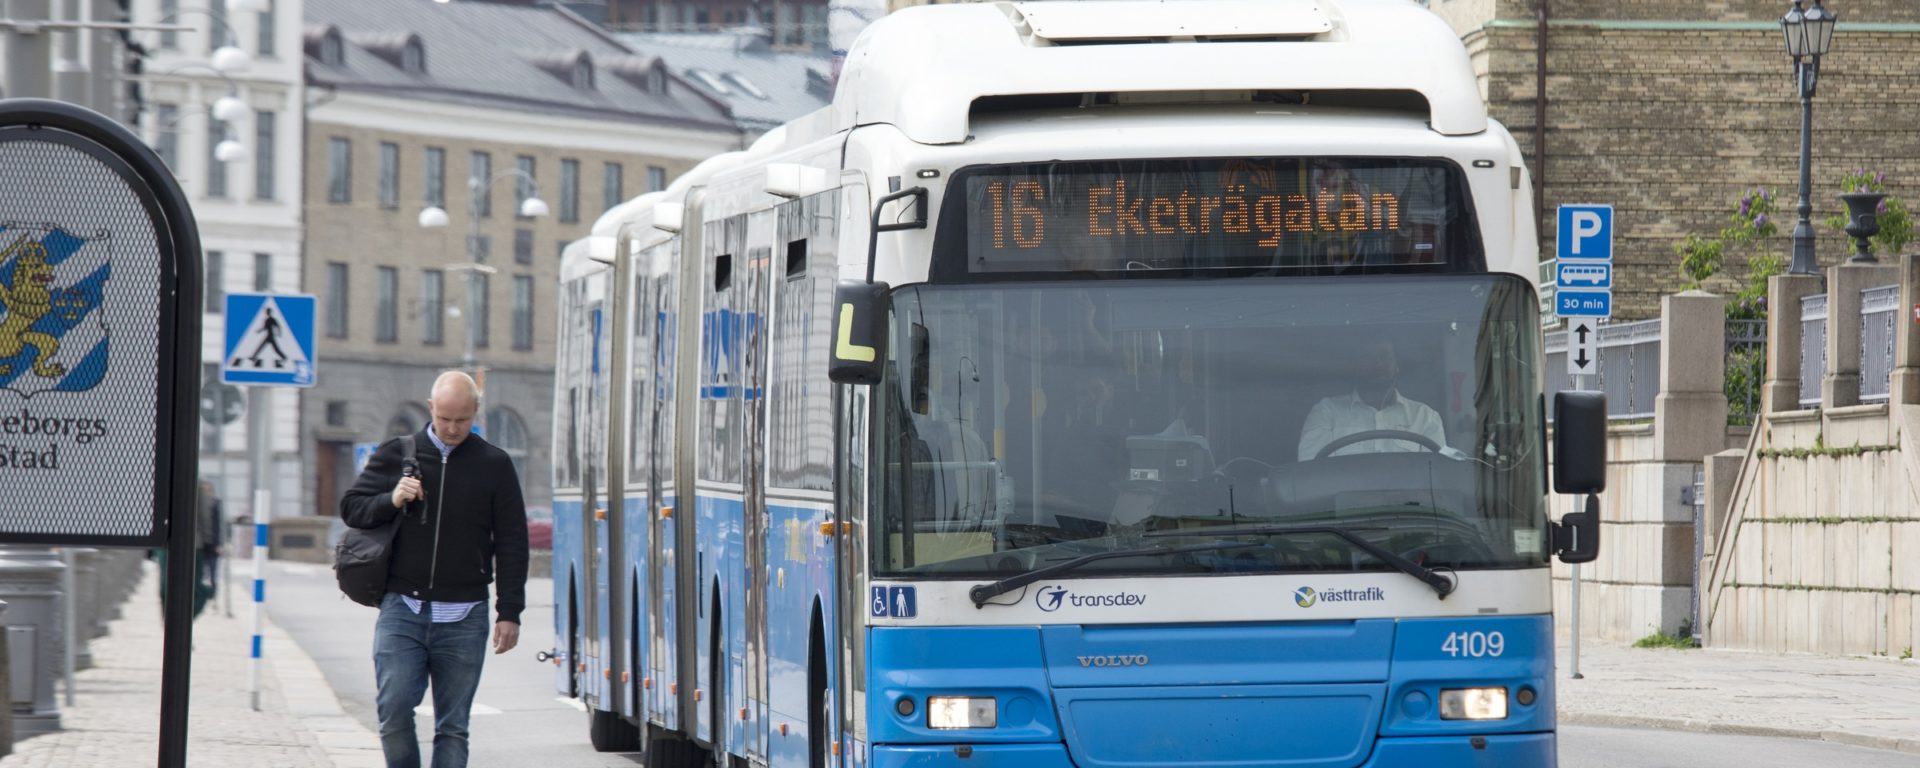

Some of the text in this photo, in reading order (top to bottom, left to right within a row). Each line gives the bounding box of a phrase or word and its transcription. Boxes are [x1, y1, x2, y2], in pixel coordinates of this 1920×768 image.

[987, 179, 1399, 248] 16 Eketrägatan
[1572, 211, 1602, 254] P
[1563, 299, 1604, 309] 30 min
[1069, 592, 1146, 607] transdev
[1319, 587, 1384, 602] västtrafik
[1441, 631, 1504, 657] 4109
[1076, 654, 1149, 668] VOLVO
